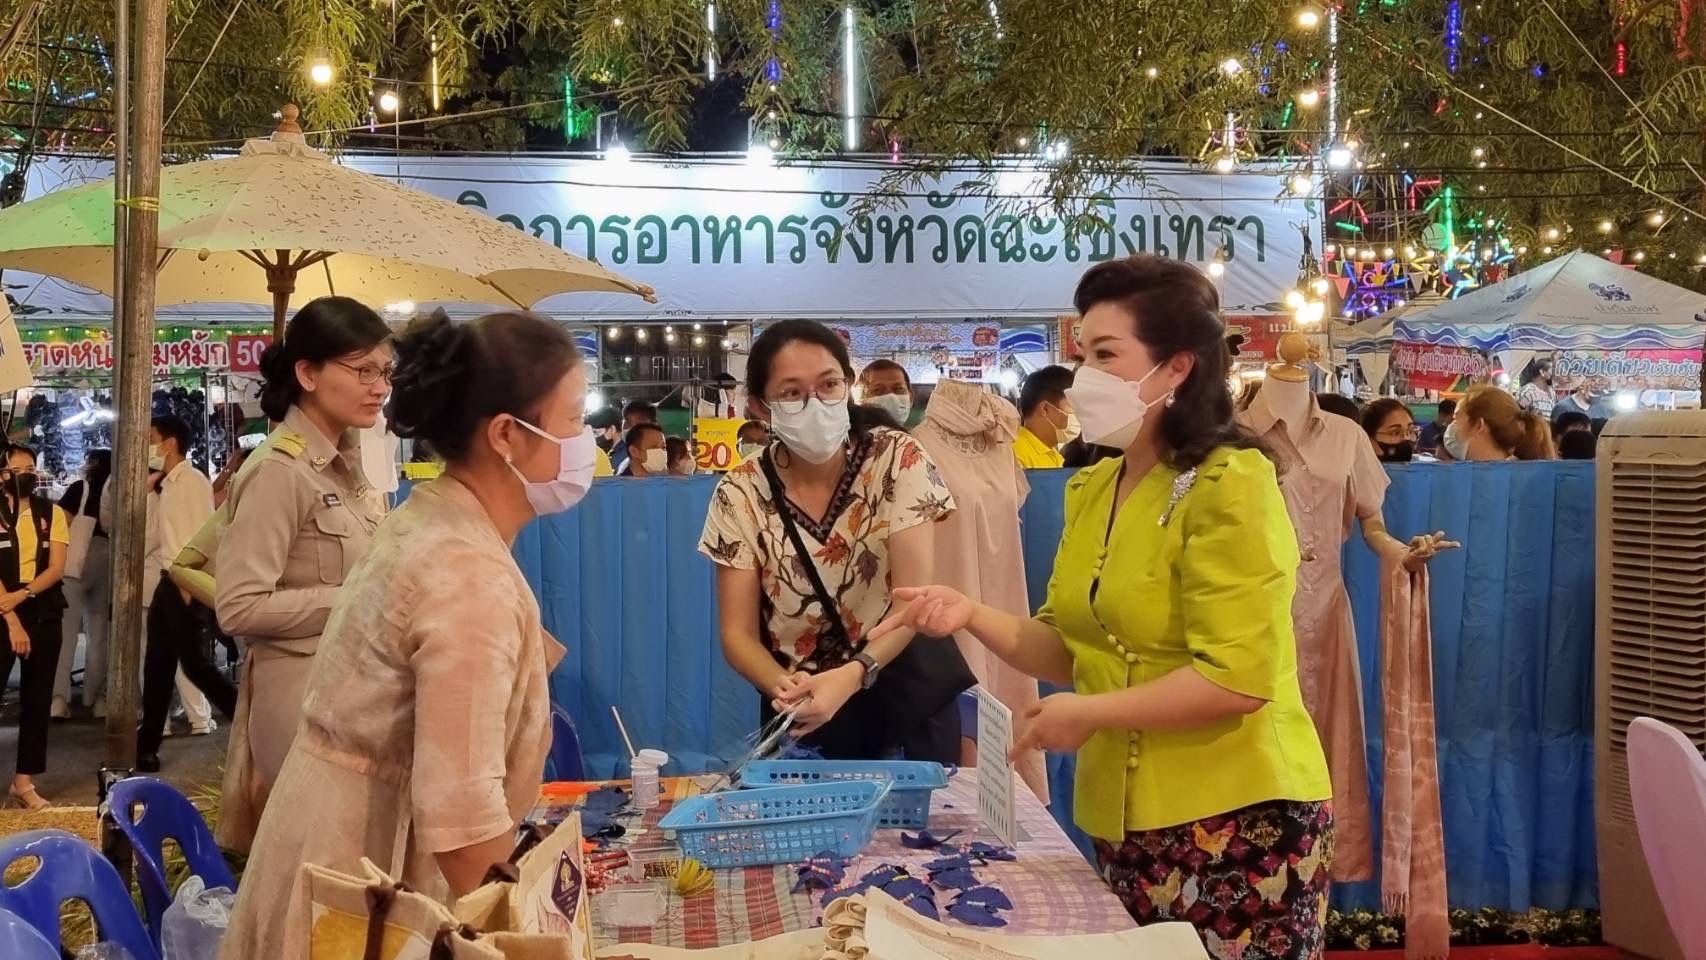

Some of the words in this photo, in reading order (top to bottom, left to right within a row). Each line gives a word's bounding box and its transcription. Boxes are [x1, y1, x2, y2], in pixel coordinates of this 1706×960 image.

[456, 189, 1266, 264] ิการอาหารจังหวัดฉะเชิงเทรา
[695, 441, 732, 469] 20
